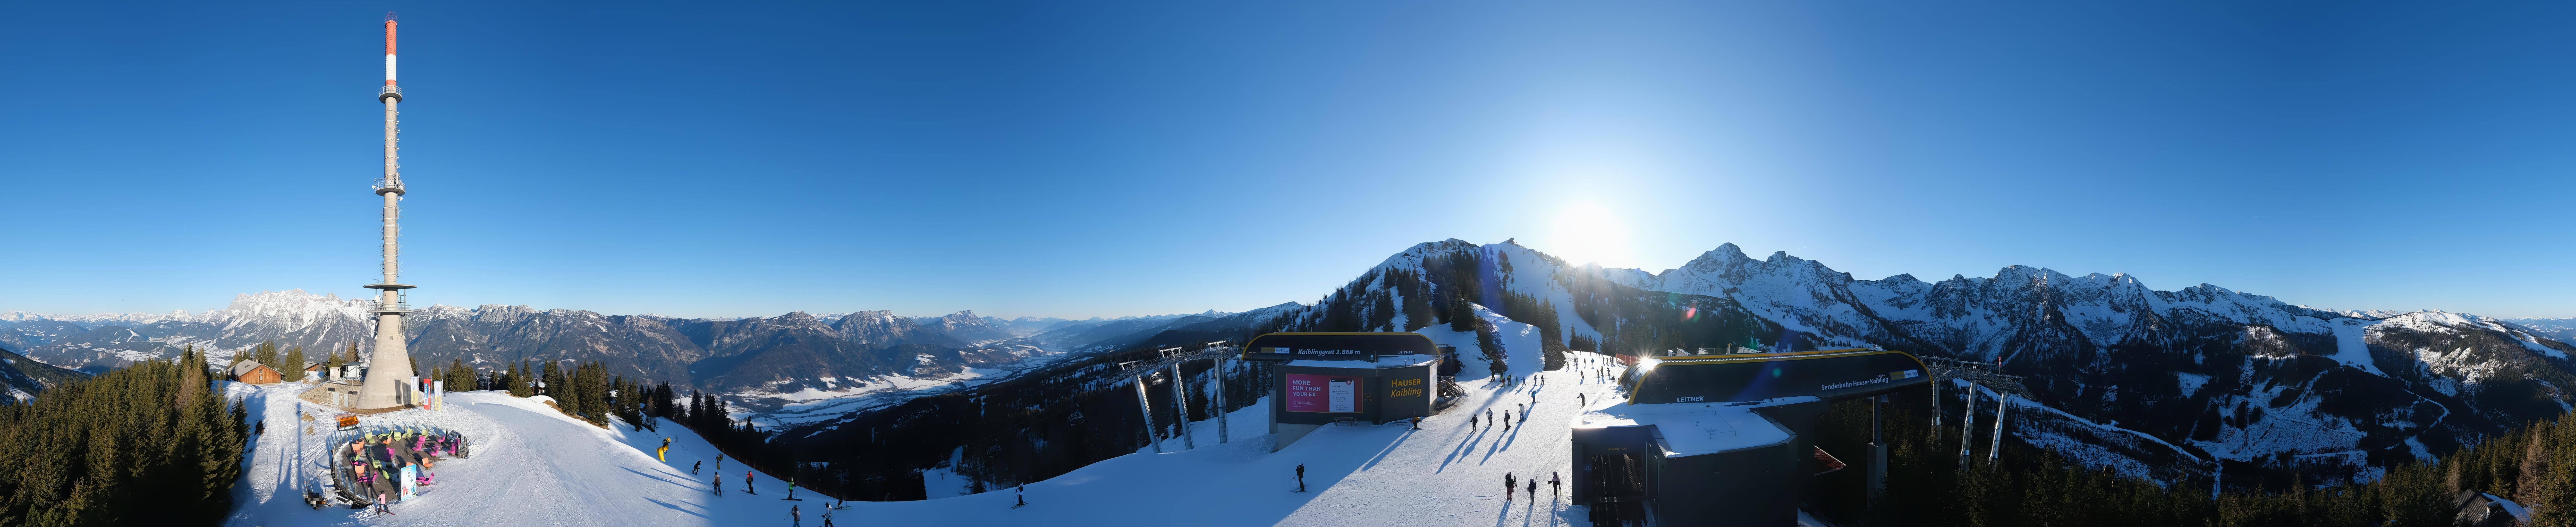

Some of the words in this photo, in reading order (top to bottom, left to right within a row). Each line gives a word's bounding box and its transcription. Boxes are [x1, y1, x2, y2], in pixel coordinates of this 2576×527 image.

[1392, 379, 1421, 387] HAUSER
[1822, 382, 1852, 390] Senderbahn
[1391, 387, 1421, 397] Kaibling
